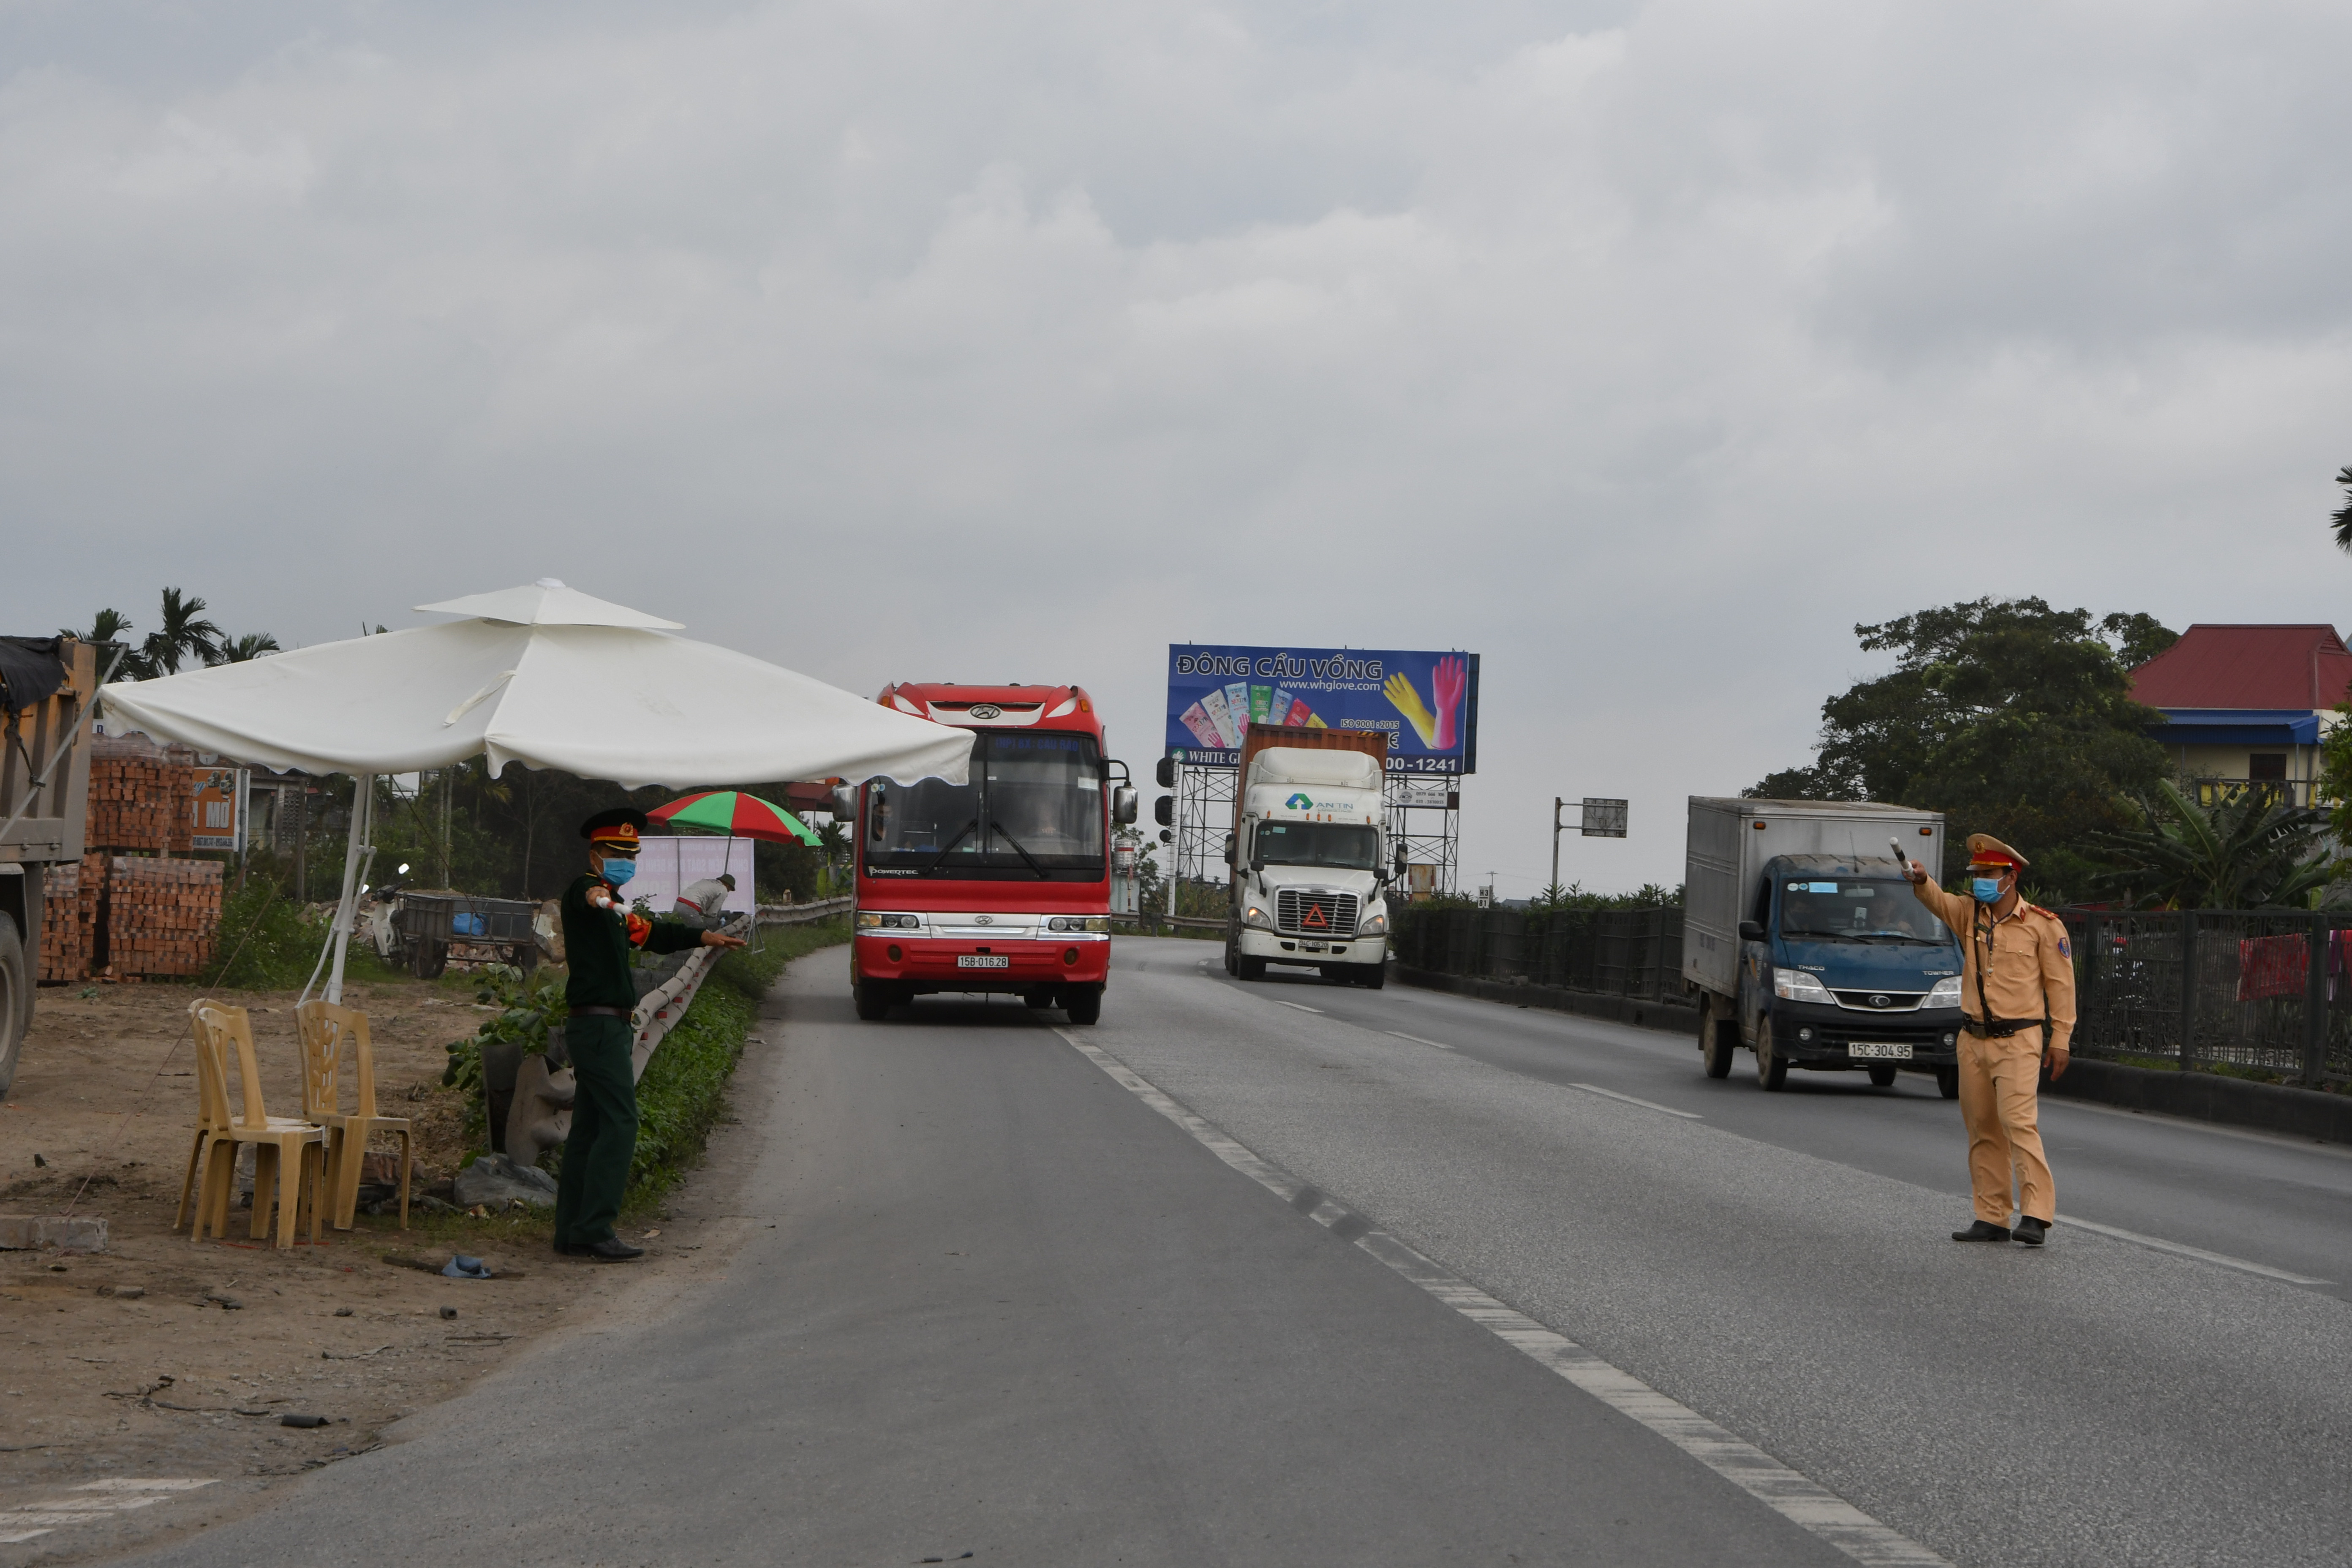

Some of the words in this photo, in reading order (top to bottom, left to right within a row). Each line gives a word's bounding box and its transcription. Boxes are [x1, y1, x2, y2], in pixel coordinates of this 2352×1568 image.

[1176, 652, 1250, 676] ĐÔNG
[1255, 653, 1306, 678] CẦU
[1310, 654, 1383, 680] VỒNG
[1279, 680, 1380, 692] www.whglove.com
[1341, 719, 1354, 727] ISO
[1189, 751, 1225, 763] WHITE
[868, 866, 919, 876] POWERTEC
[961, 957, 1007, 966] 15B-016.28
[1852, 1044, 1910, 1057] 15C-304.95
